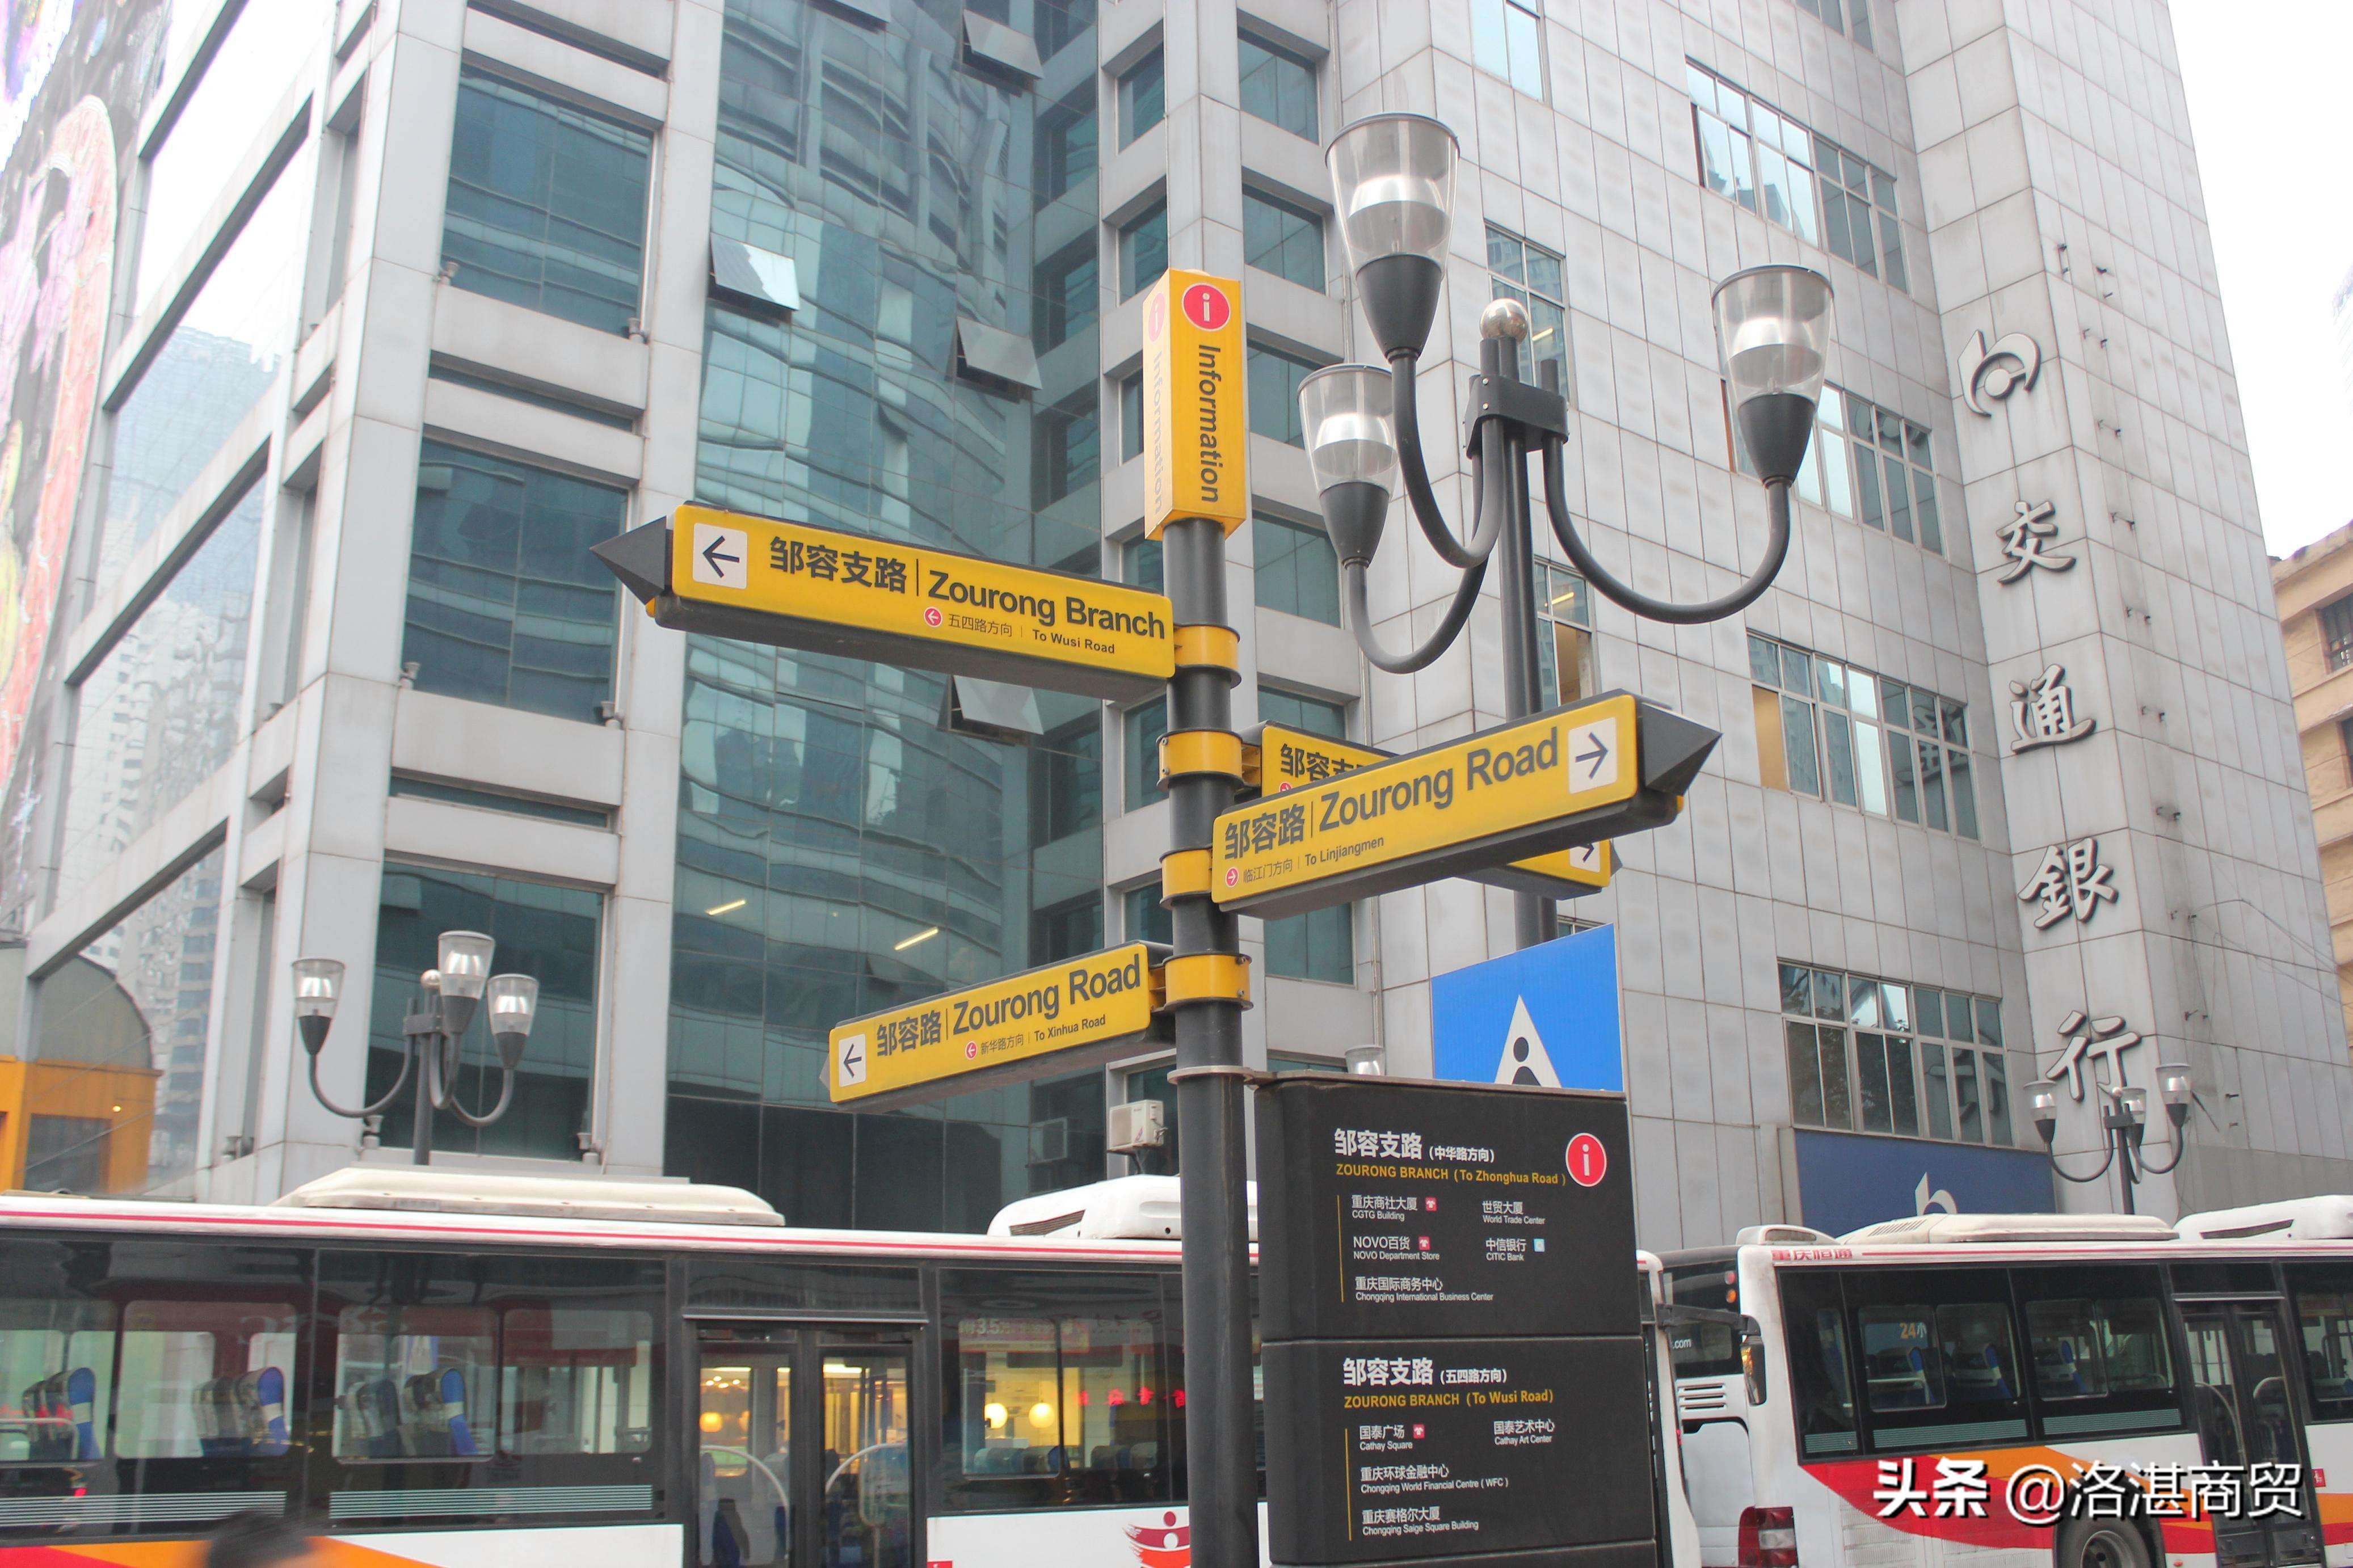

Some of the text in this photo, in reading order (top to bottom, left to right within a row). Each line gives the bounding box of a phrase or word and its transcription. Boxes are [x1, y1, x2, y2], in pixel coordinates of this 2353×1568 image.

[1199, 345, 1223, 502] Information
[770, 536, 1164, 639] 邹容支路 Zourong Branch
[949, 614, 1114, 654] 五四路方向 To Wusi Road
[1281, 743, 1363, 782] 邹容
[1225, 727, 1558, 859] 邹容路 Zourong Road
[1244, 837, 1383, 883] 临江门方向 To Linjiangmen
[877, 954, 1140, 1056] 邹容路 Zourong Road
[981, 1014, 1105, 1055] 新华路方向 To Xinhua Road
[1335, 1128, 1422, 1159] 邹容支路
[1337, 1164, 1396, 1177] ZOURONG
[1400, 1167, 1448, 1179] BRANCH
[1476, 1170, 1529, 1185] Zhonghua
[1352, 1195, 1417, 1211] 重庆商社大厦
[1482, 1201, 1523, 1215] 世贸大厦
[1377, 1211, 1404, 1221] Building
[1504, 1215, 1522, 1224] Trade
[1354, 1237, 1409, 1250] NOVO百货
[1486, 1238, 1526, 1251] 中信银行
[1354, 1251, 1439, 1261] NOVO Department Store
[1771, 1249, 1853, 1261] 重庆恒通
[1356, 1276, 1443, 1291] 重庆国际商务中心
[1356, 1292, 1394, 1303] Chongqing
[1343, 1358, 1433, 1386] 邹容支路
[1345, 1395, 1405, 1408] ZOURONG
[1410, 1394, 1459, 1406] BRANCH
[1489, 1391, 1517, 1403] Wusi
[1360, 1425, 1404, 1440] 国泰广场
[1494, 1419, 1555, 1435] 国泰艺术中心
[1360, 1441, 1412, 1452] Cathay Square
[1495, 1436, 1518, 1446] Cathay
[1530, 1435, 1552, 1443] Center
[1361, 1464, 1449, 1481] 重庆环球金融中心
[1361, 1483, 1400, 1494] Chongqing
[1401, 1482, 1422, 1491] World
[1424, 1481, 1454, 1490] Financial
[1456, 1480, 1479, 1489] Centre
[1362, 1506, 1440, 1524] 重庆赛格尔大厦
[1363, 1521, 1479, 1536] Chongqing Saige Square Building
